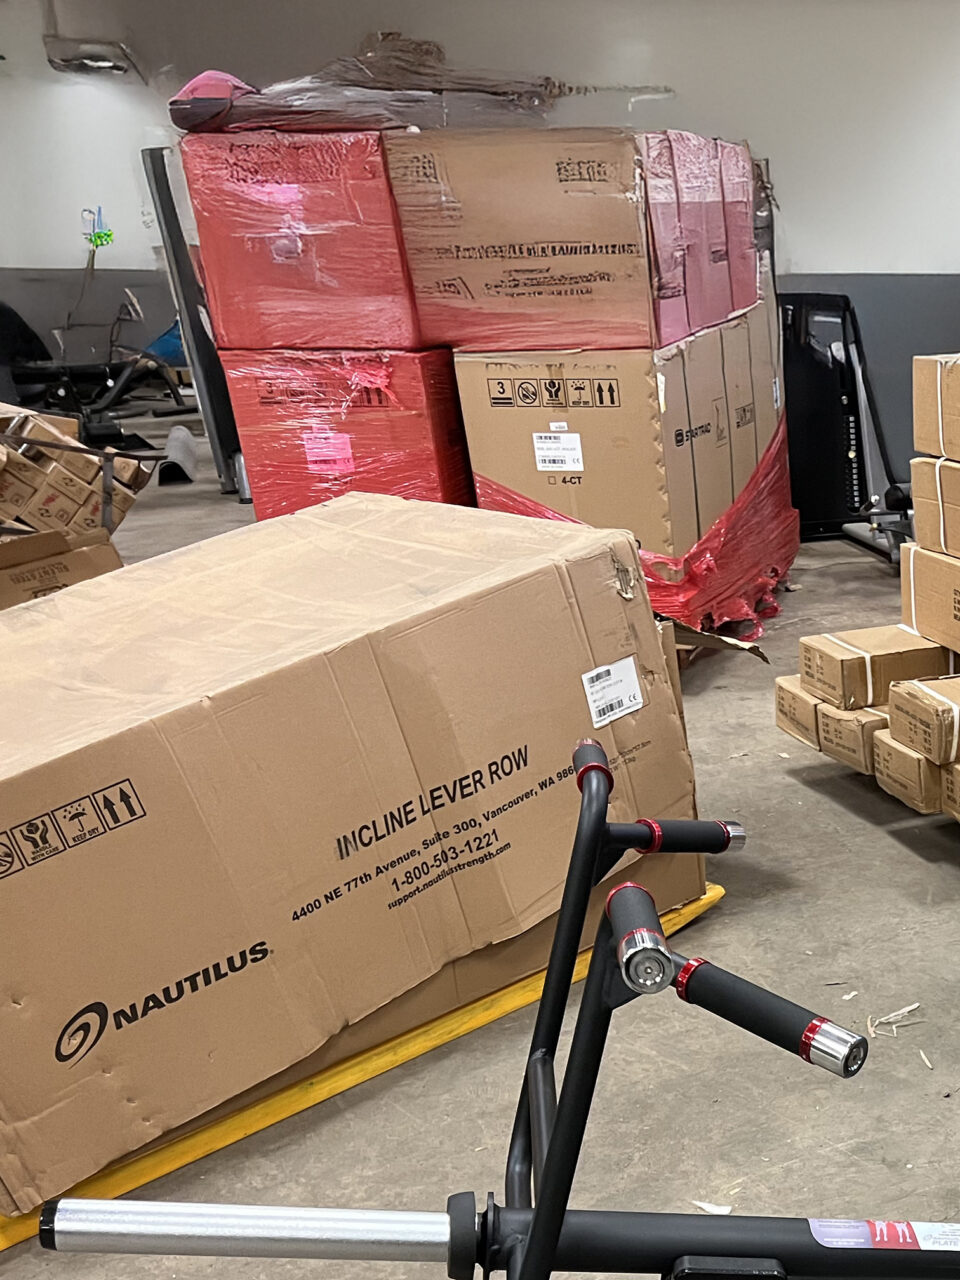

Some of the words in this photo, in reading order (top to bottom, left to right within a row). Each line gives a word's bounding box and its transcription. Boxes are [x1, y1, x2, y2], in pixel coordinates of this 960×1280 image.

[497, 381, 505, 394] 3
[561, 476, 583, 485] 4-CT
[335, 801, 418, 861] INCLINE
[419, 769, 486, 817] LEVER
[487, 744, 529, 785] ROW
[31, 843, 52, 855] HANDLE
[45, 846, 60, 856] CARE
[72, 833, 87, 844] KEEP
[87, 827, 100, 837] DRY
[292, 899, 322, 921] 4400
[323, 886, 343, 904] NE
[343, 872, 372, 892] 77th
[375, 849, 421, 877] Avenue,
[422, 830, 450, 850] Suite
[452, 818, 482, 835] 300,
[482, 788, 538, 822] Vancouver,
[538, 776, 555, 791] WA
[556, 766, 577, 782] 986
[387, 842, 512, 910] support.nautilusstrength.com
[391, 828, 499, 892] 1-800-503-1221
[112, 940, 270, 1031] NAUTILUS
